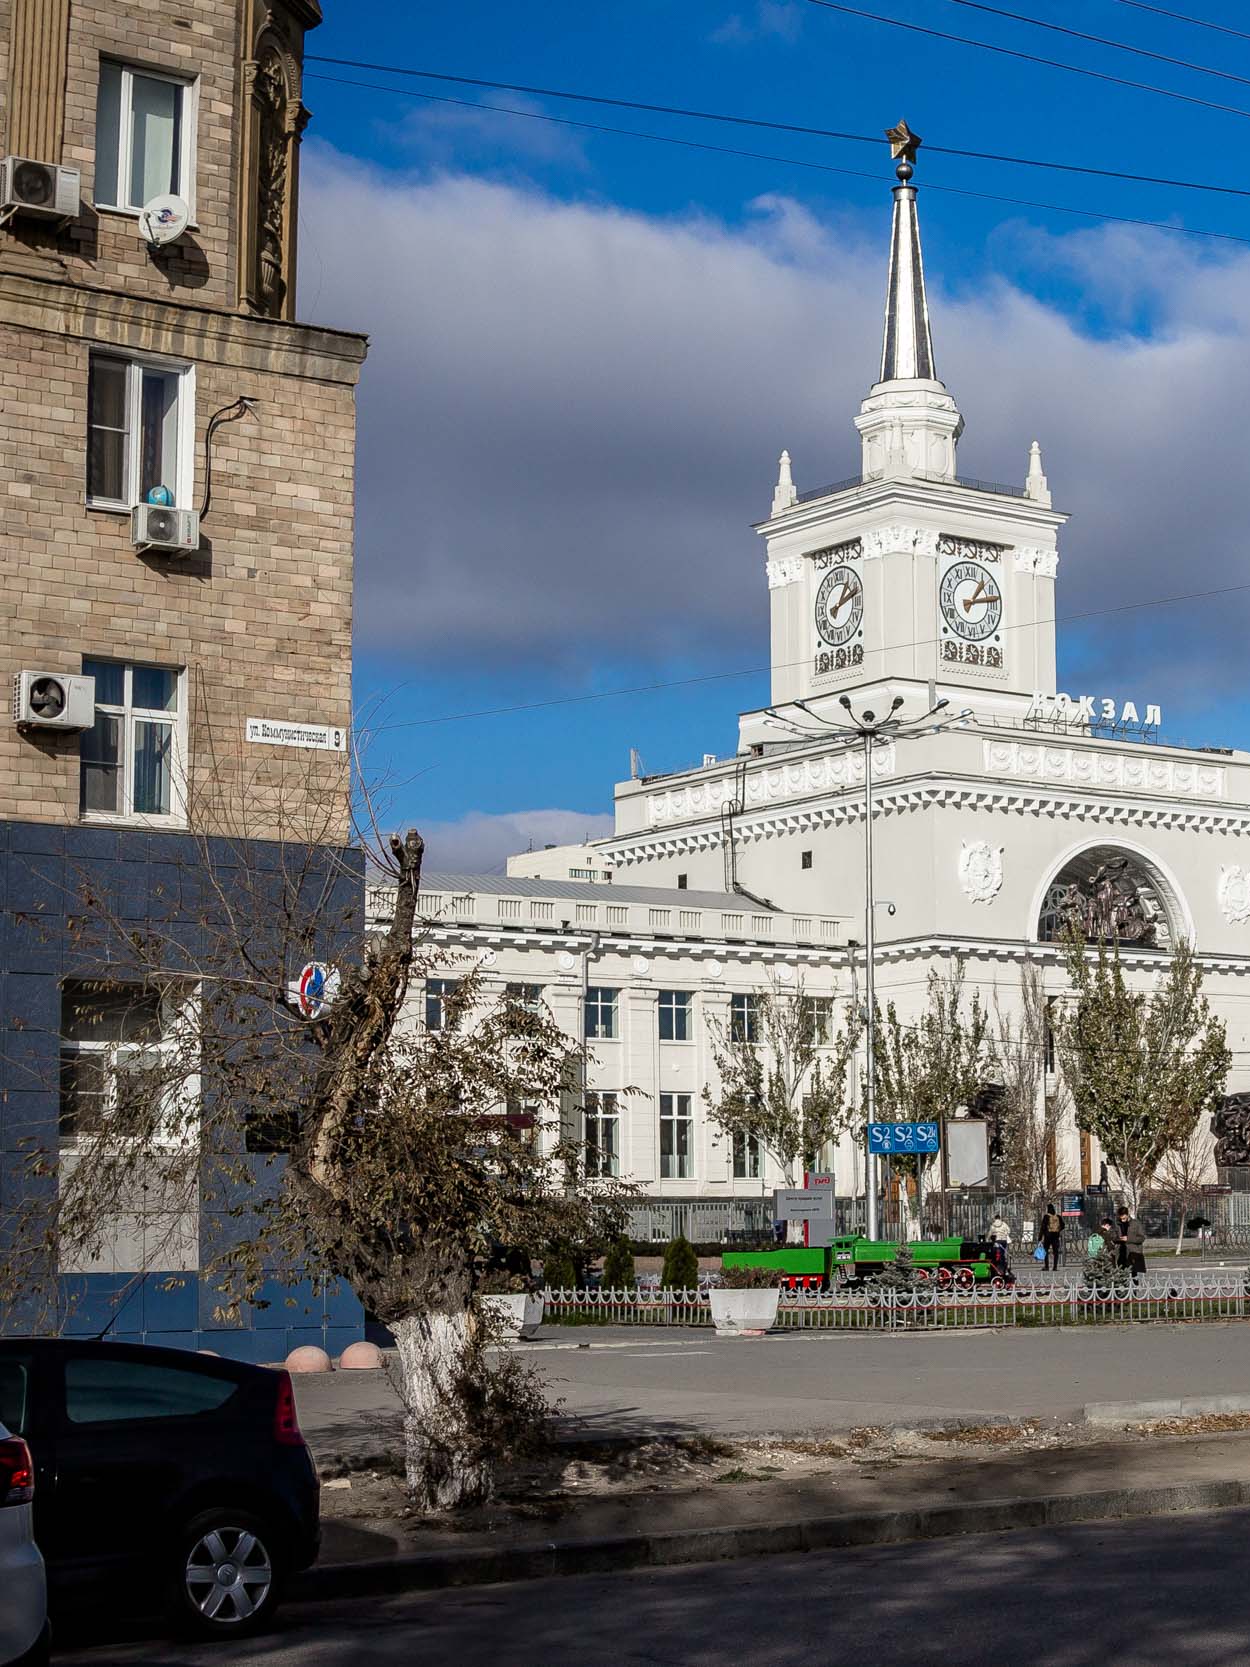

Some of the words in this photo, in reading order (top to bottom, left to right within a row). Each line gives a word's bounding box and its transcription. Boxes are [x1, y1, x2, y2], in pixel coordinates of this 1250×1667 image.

[1032, 690, 1161, 725] ВОКЗАЛ
[250, 724, 260, 739] ул.
[261, 723, 327, 744] Коммунистическая
[334, 730, 340, 747] 9
